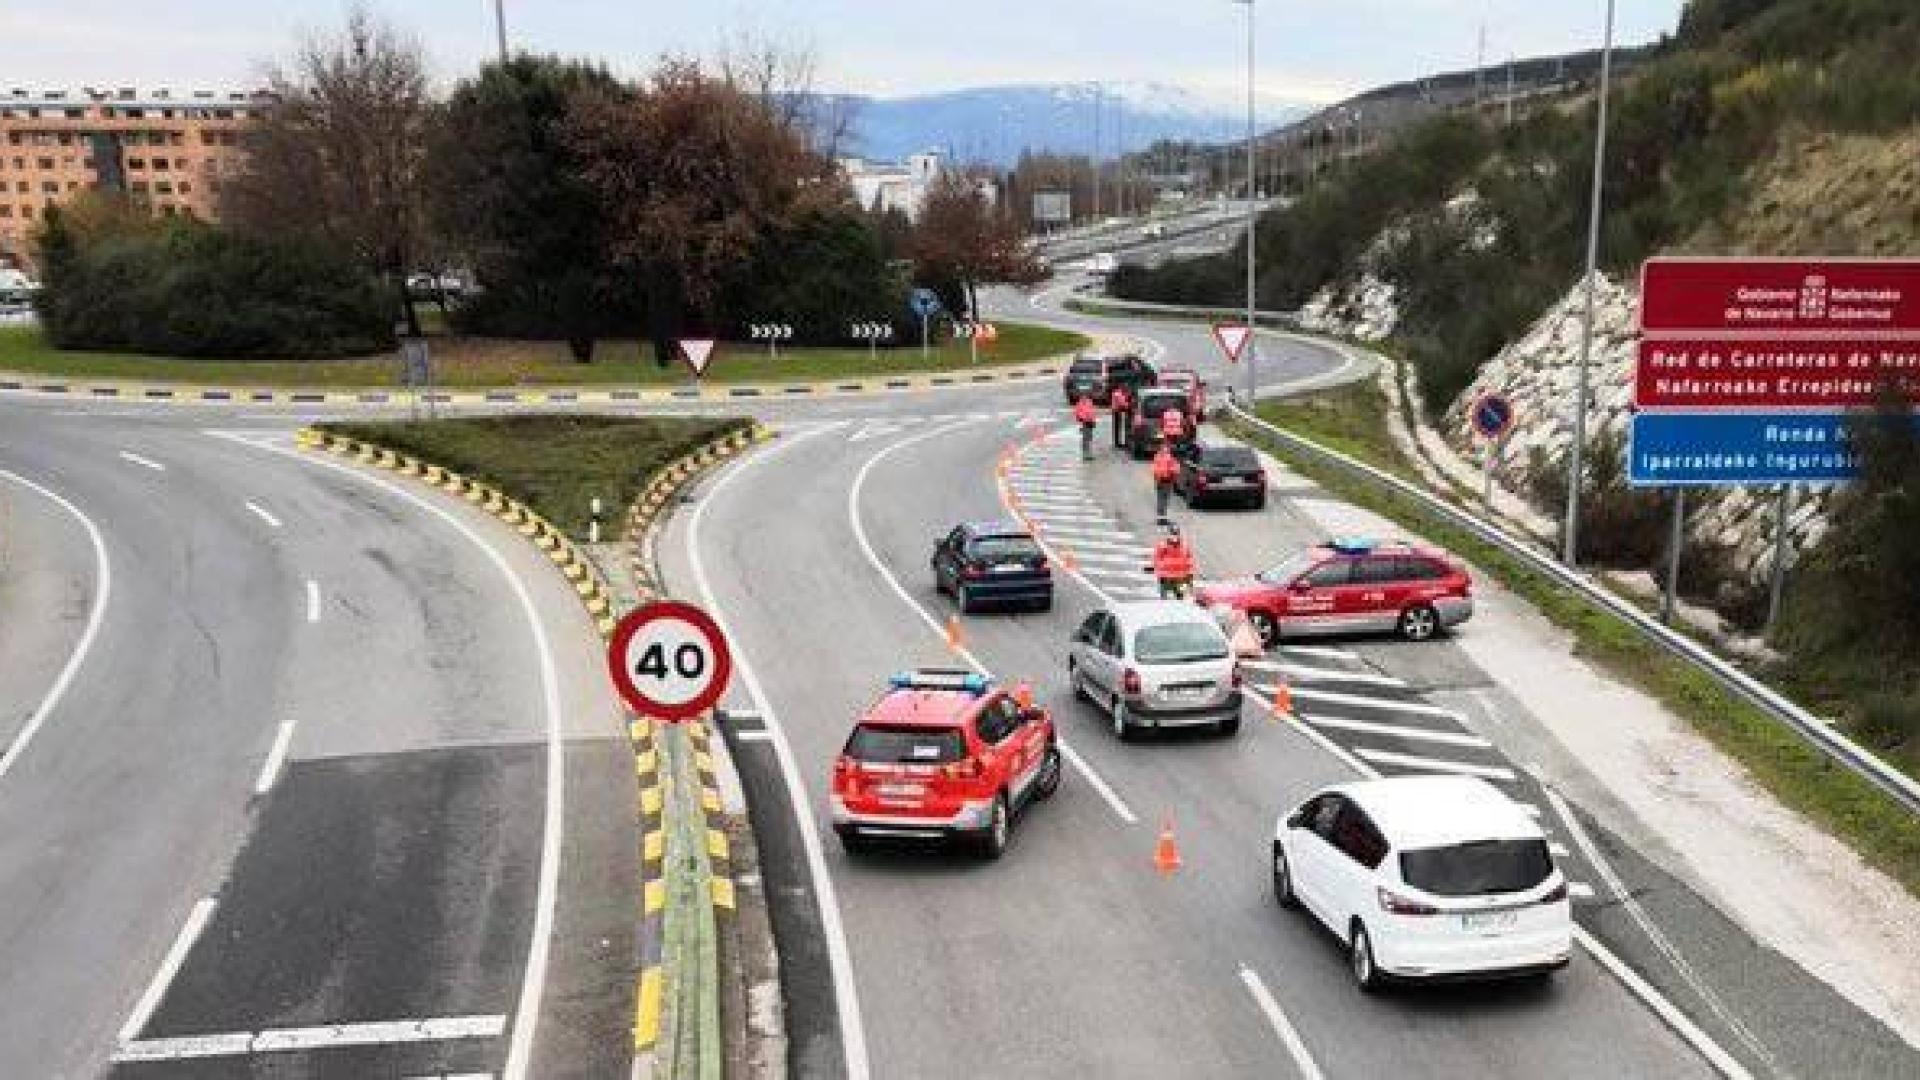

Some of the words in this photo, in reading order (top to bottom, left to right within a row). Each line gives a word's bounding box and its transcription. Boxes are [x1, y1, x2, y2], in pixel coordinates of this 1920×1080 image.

[1652, 350, 1688, 367] Red
[1698, 350, 1721, 367] de
[1731, 350, 1838, 367] Carreteras
[1848, 350, 1870, 367] de
[1656, 379, 1768, 393] Nafarroako
[1766, 424, 1826, 441] Ronda
[1643, 453, 1757, 470] Iparraldeko
[635, 641, 704, 679] 40
